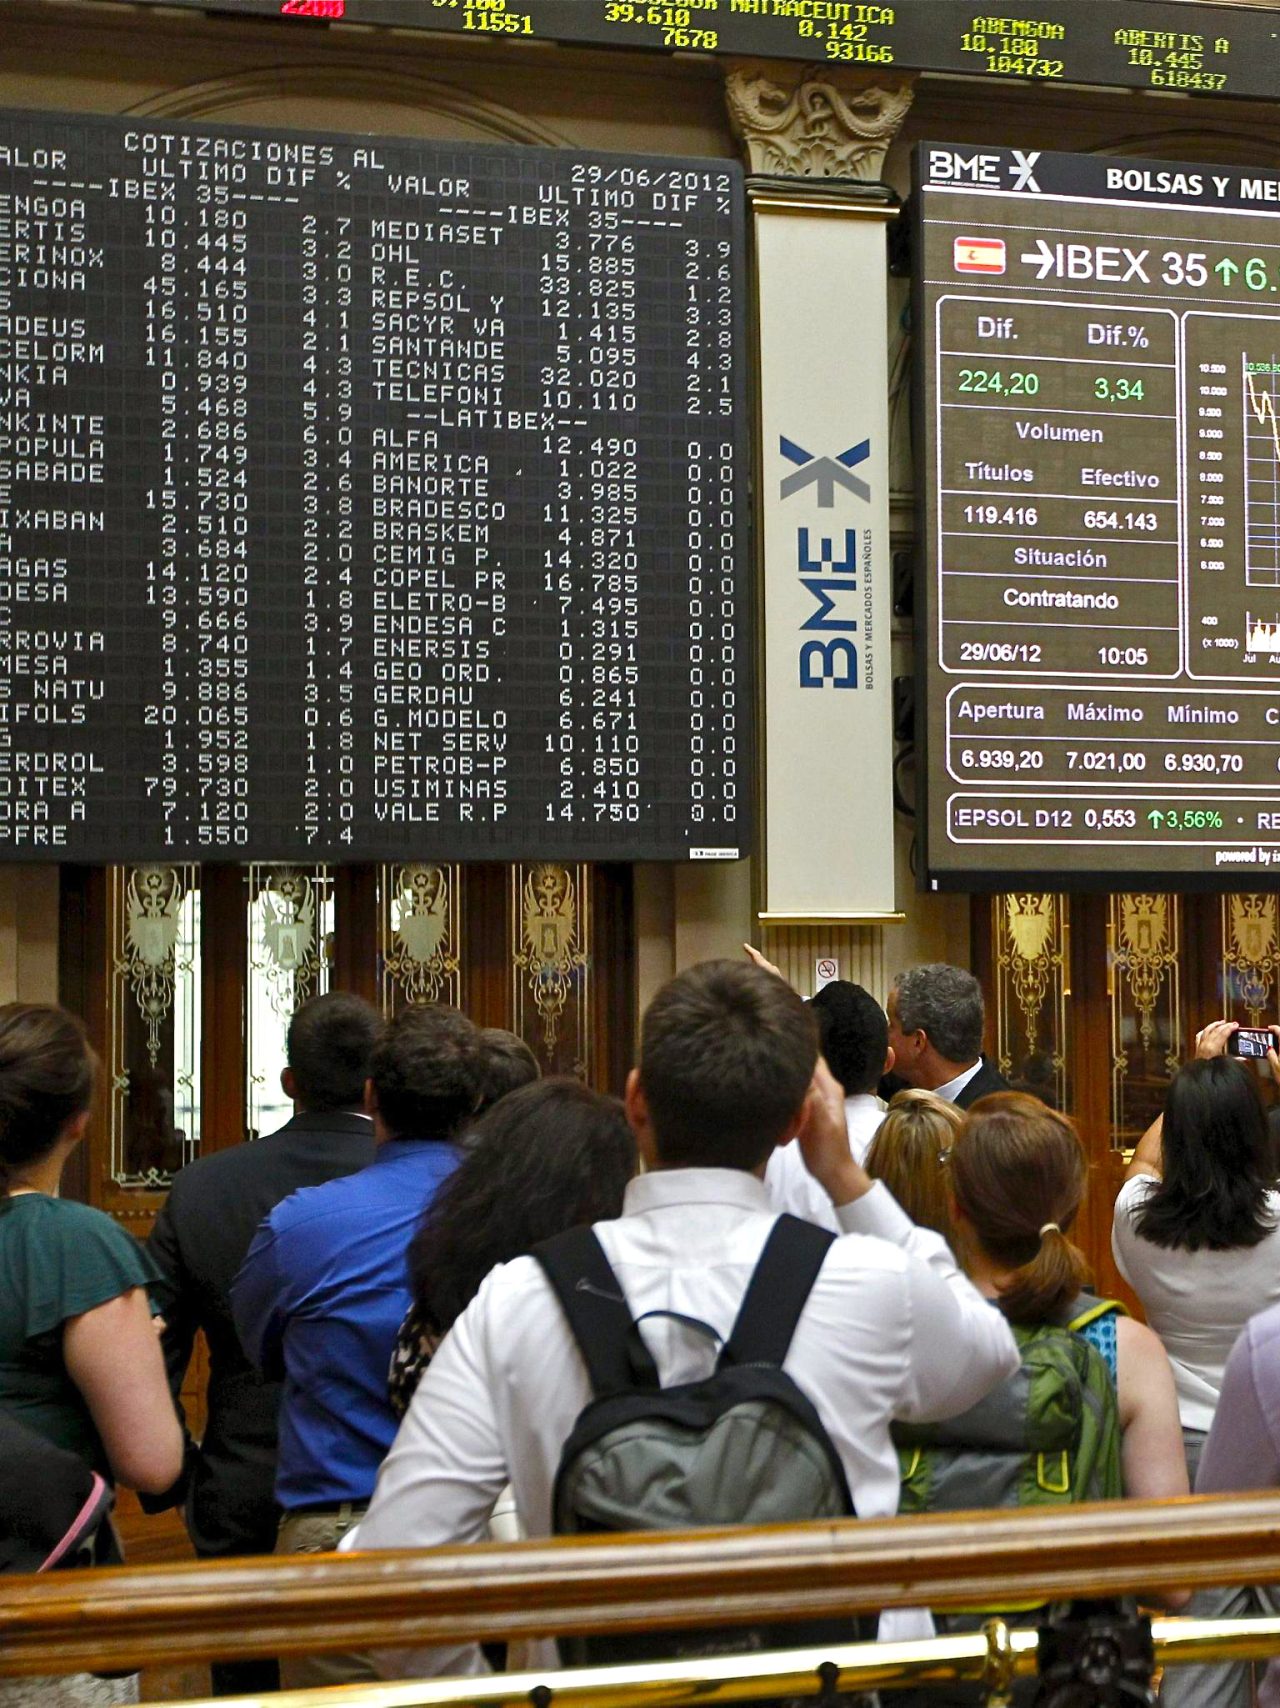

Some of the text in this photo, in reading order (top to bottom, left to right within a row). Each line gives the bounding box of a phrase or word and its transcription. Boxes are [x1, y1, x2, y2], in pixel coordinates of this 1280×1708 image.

[463, 11, 533, 34] 11551
[799, 20, 867, 41] 0.142
[661, 27, 717, 48] 7678
[826, 41, 893, 62] 93166
[1128, 48, 1203, 69] 10.445
[125, 133, 384, 169] COTIZACIONES AL
[572, 165, 729, 192] 29/06/2012
[929, 150, 1000, 183] BME
[388, 175, 469, 197] VALOR
[1107, 169, 1203, 195] BOLSAS
[1212, 177, 1229, 197] Y
[539, 185, 729, 214] ULTIMO DIF %
[372, 220, 730, 258] MEDIASET 3.776 3.9
[372, 244, 730, 281] OHL 15.885 2.6
[1056, 244, 1150, 283] IBEX
[1162, 252, 1207, 286] 35
[979, 317, 1148, 347] Dif. Dif.%
[959, 370, 1144, 402] 224,20 3,34
[1016, 422, 1103, 442] Volumen
[965, 462, 1159, 487] Títulos Efectivo
[374, 475, 732, 505] BANORTE 3.985 0.0
[964, 506, 1157, 530] 119.416 654.143
[862, 529, 871, 585] ESPAÑOLES
[1015, 548, 1106, 567] Situación
[147, 561, 247, 582] 14.120
[798, 527, 858, 688] BME
[1004, 589, 1118, 609] Contratando
[865, 587, 873, 642] MERCADOS
[961, 643, 1148, 665] 29/06/12 10:05
[1243, 654, 1256, 663] Jul
[865, 653, 873, 690] BOLSAS
[374, 686, 734, 708] GERDAU 6.241 0.0
[958, 701, 1044, 722] Apertura
[1068, 703, 1143, 721] Máximo
[962, 750, 1043, 771] 6.939,20
[1067, 752, 1145, 773] 7.021,00
[1165, 754, 1242, 774] 6.930,70
[955, 809, 1029, 826] EPSOL
[1036, 810, 1072, 827] D12
[1085, 809, 1136, 830] 0,553
[1167, 811, 1222, 830] 3,56%
